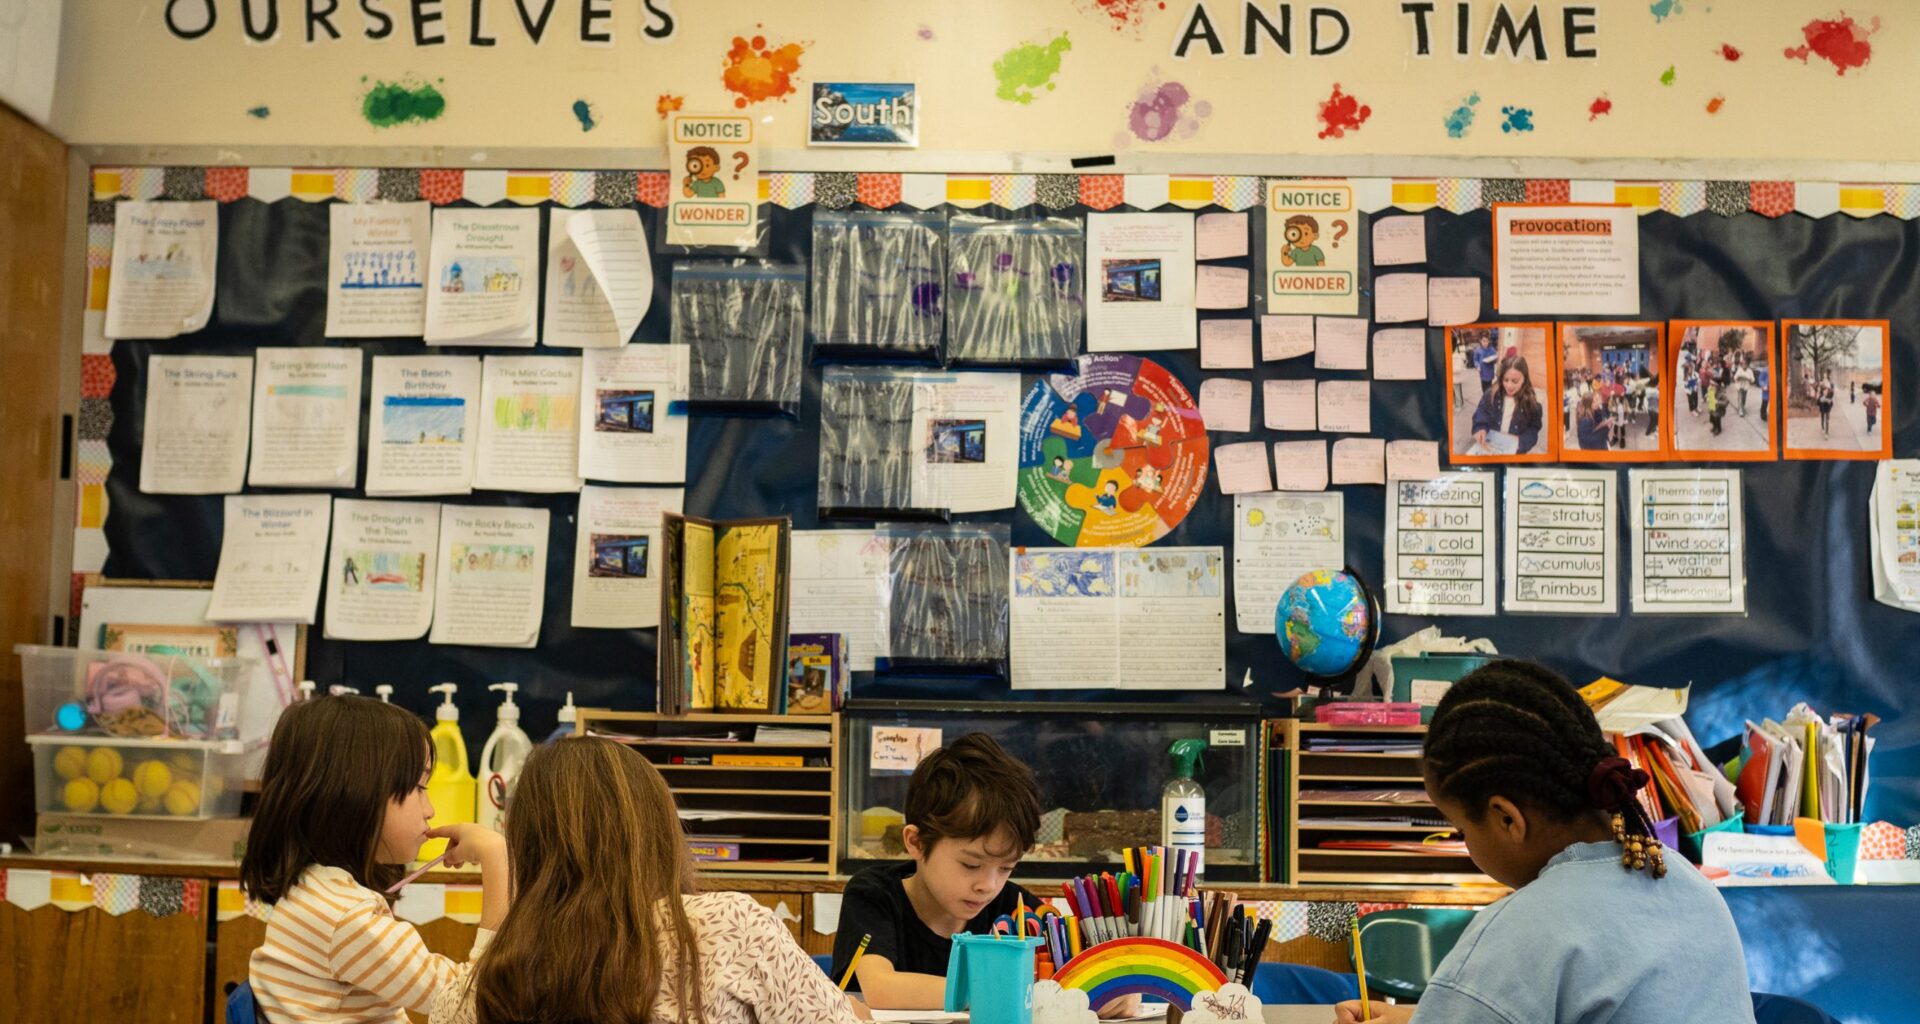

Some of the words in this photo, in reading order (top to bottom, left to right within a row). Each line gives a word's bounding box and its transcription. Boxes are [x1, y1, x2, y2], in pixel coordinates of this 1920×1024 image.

[165, 0, 674, 46] OURSELVES
[1174, 2, 1350, 57] AND
[1402, 3, 1597, 60] TIME
[816, 97, 910, 126] South
[683, 123, 742, 137] NOTICE
[1281, 192, 1342, 206] NOTICE
[679, 208, 745, 220] WONDER
[453, 222, 468, 230] The
[472, 222, 520, 231] Disastrous
[1510, 219, 1612, 232] Provocation:
[466, 234, 504, 244] Drought
[1278, 276, 1346, 290] WONDER
[270, 361, 302, 372] Spring
[164, 369, 180, 378] The
[401, 368, 418, 378] The
[421, 368, 452, 378] Beach
[500, 368, 516, 378] The
[518, 368, 537, 378] Mini
[540, 368, 572, 378] Cactus
[404, 381, 447, 391] Birthday
[1420, 488, 1481, 504] freezing
[1554, 486, 1600, 500] cloud
[242, 508, 260, 517] The
[352, 512, 369, 523] The
[371, 514, 411, 525] Drought
[1444, 511, 1470, 526] hot
[1552, 510, 1602, 523] stratus
[1655, 512, 1680, 521] rain
[1682, 512, 1725, 524] gauge
[456, 518, 472, 528] The
[475, 519, 502, 530] Rocky
[504, 520, 534, 530] Beach
[365, 526, 380, 536] the
[384, 526, 407, 536] Town
[1438, 536, 1474, 550] cold
[1556, 534, 1596, 547] cirrus
[1655, 538, 1688, 549] wind
[1694, 538, 1725, 549] sock
[1432, 558, 1467, 569] mostly
[1542, 558, 1601, 572] cumulus
[1666, 556, 1724, 566] weather
[1434, 567, 1466, 578] sunny
[1678, 566, 1712, 576] vane
[1420, 581, 1474, 592] weather
[1540, 582, 1598, 596] nimbus
